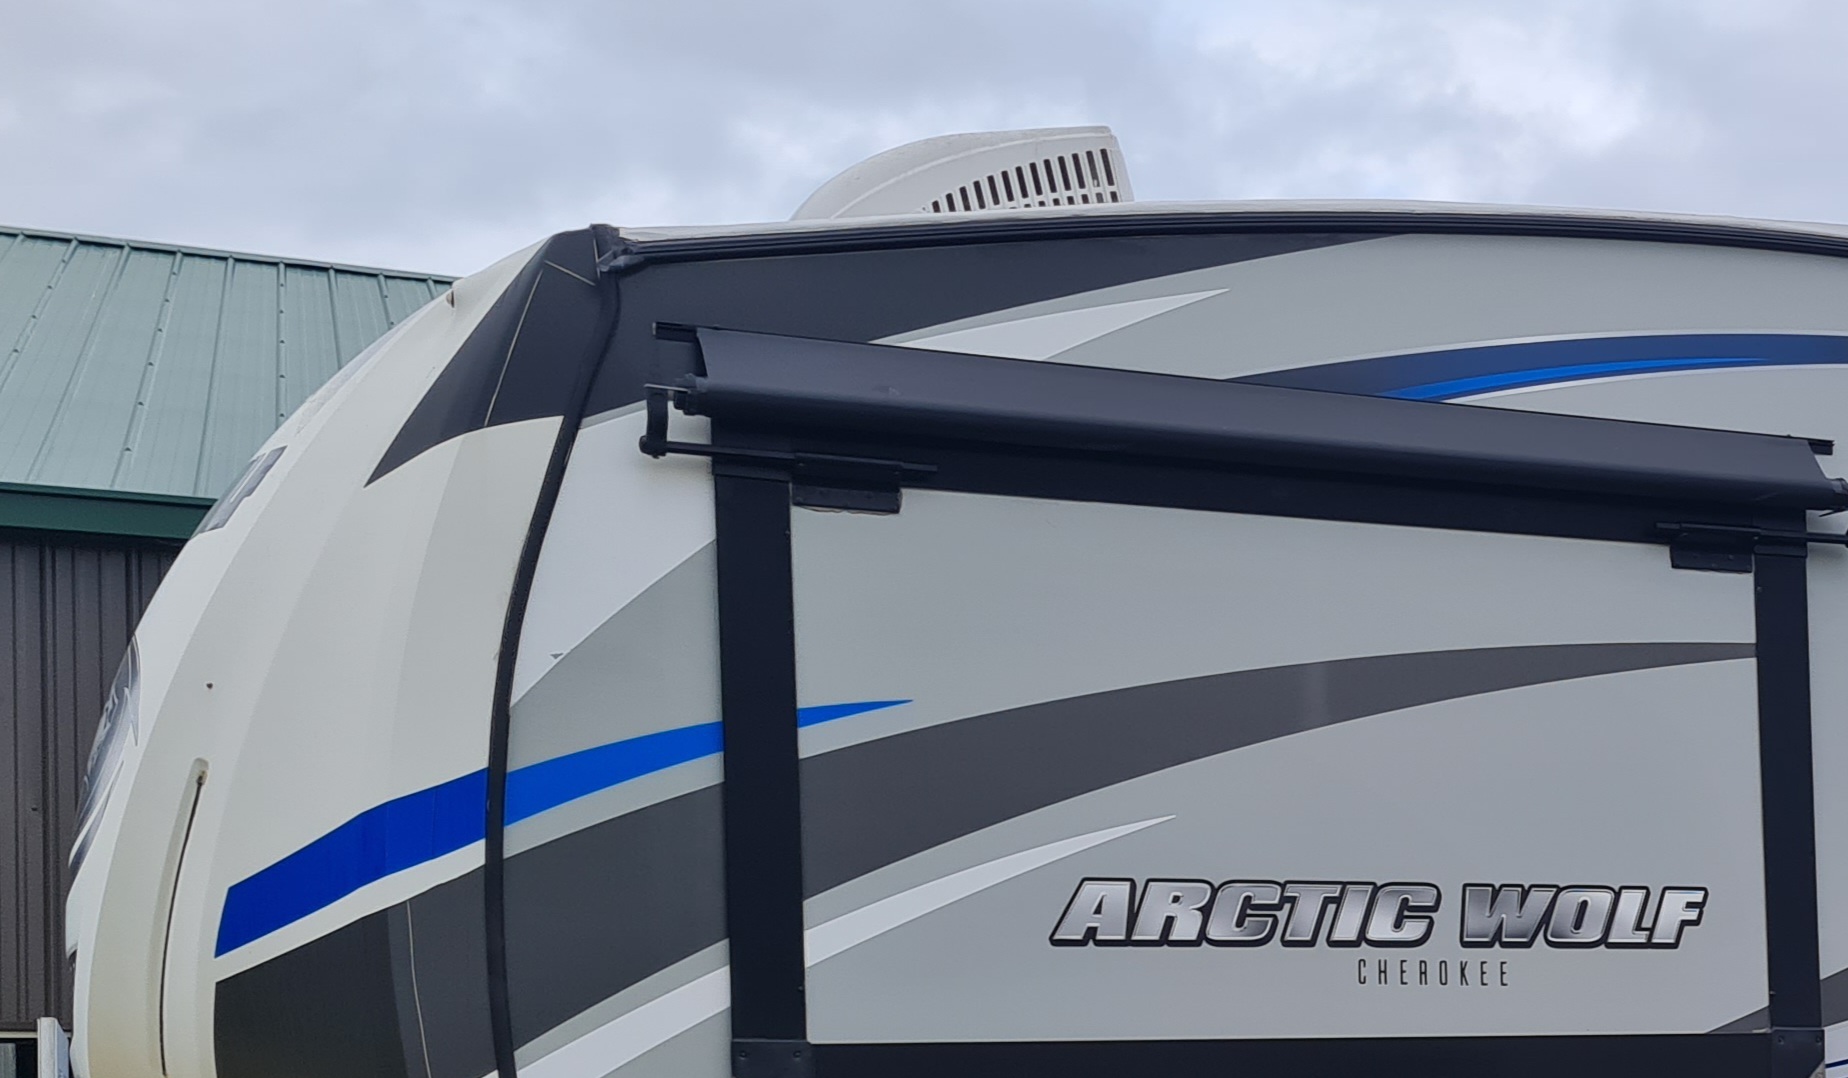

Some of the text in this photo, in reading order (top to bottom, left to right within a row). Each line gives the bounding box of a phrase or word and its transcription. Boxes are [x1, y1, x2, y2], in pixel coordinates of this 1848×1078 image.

[1049, 877, 1709, 948] ARCTIC WOLF
[1357, 959, 1510, 986] CHEROKEE
